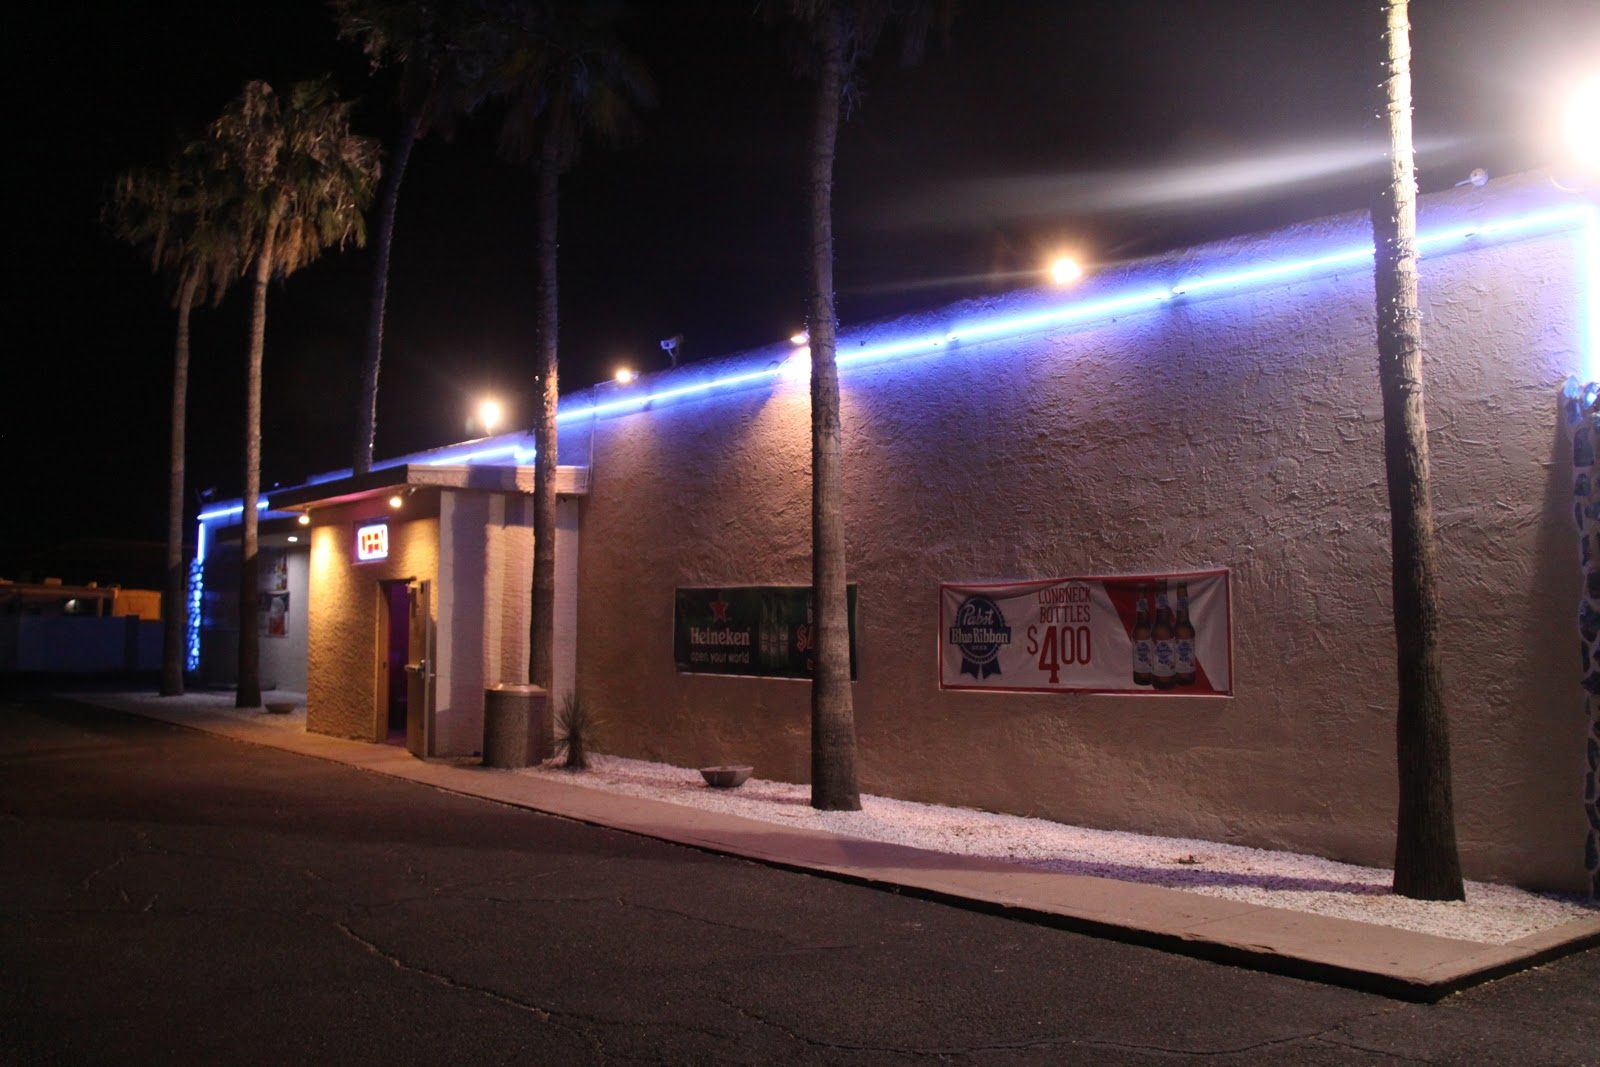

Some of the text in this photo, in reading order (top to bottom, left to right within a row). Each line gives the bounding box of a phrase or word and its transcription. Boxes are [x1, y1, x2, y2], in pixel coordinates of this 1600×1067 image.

[1038, 586, 1092, 605] LONGNECK
[963, 603, 995, 626] Pabst
[1039, 605, 1091, 624] BOTTLES
[690, 627, 750, 646] Heineken
[951, 626, 1009, 644] Blue Ribbon
[690, 651, 750, 664] open your world
